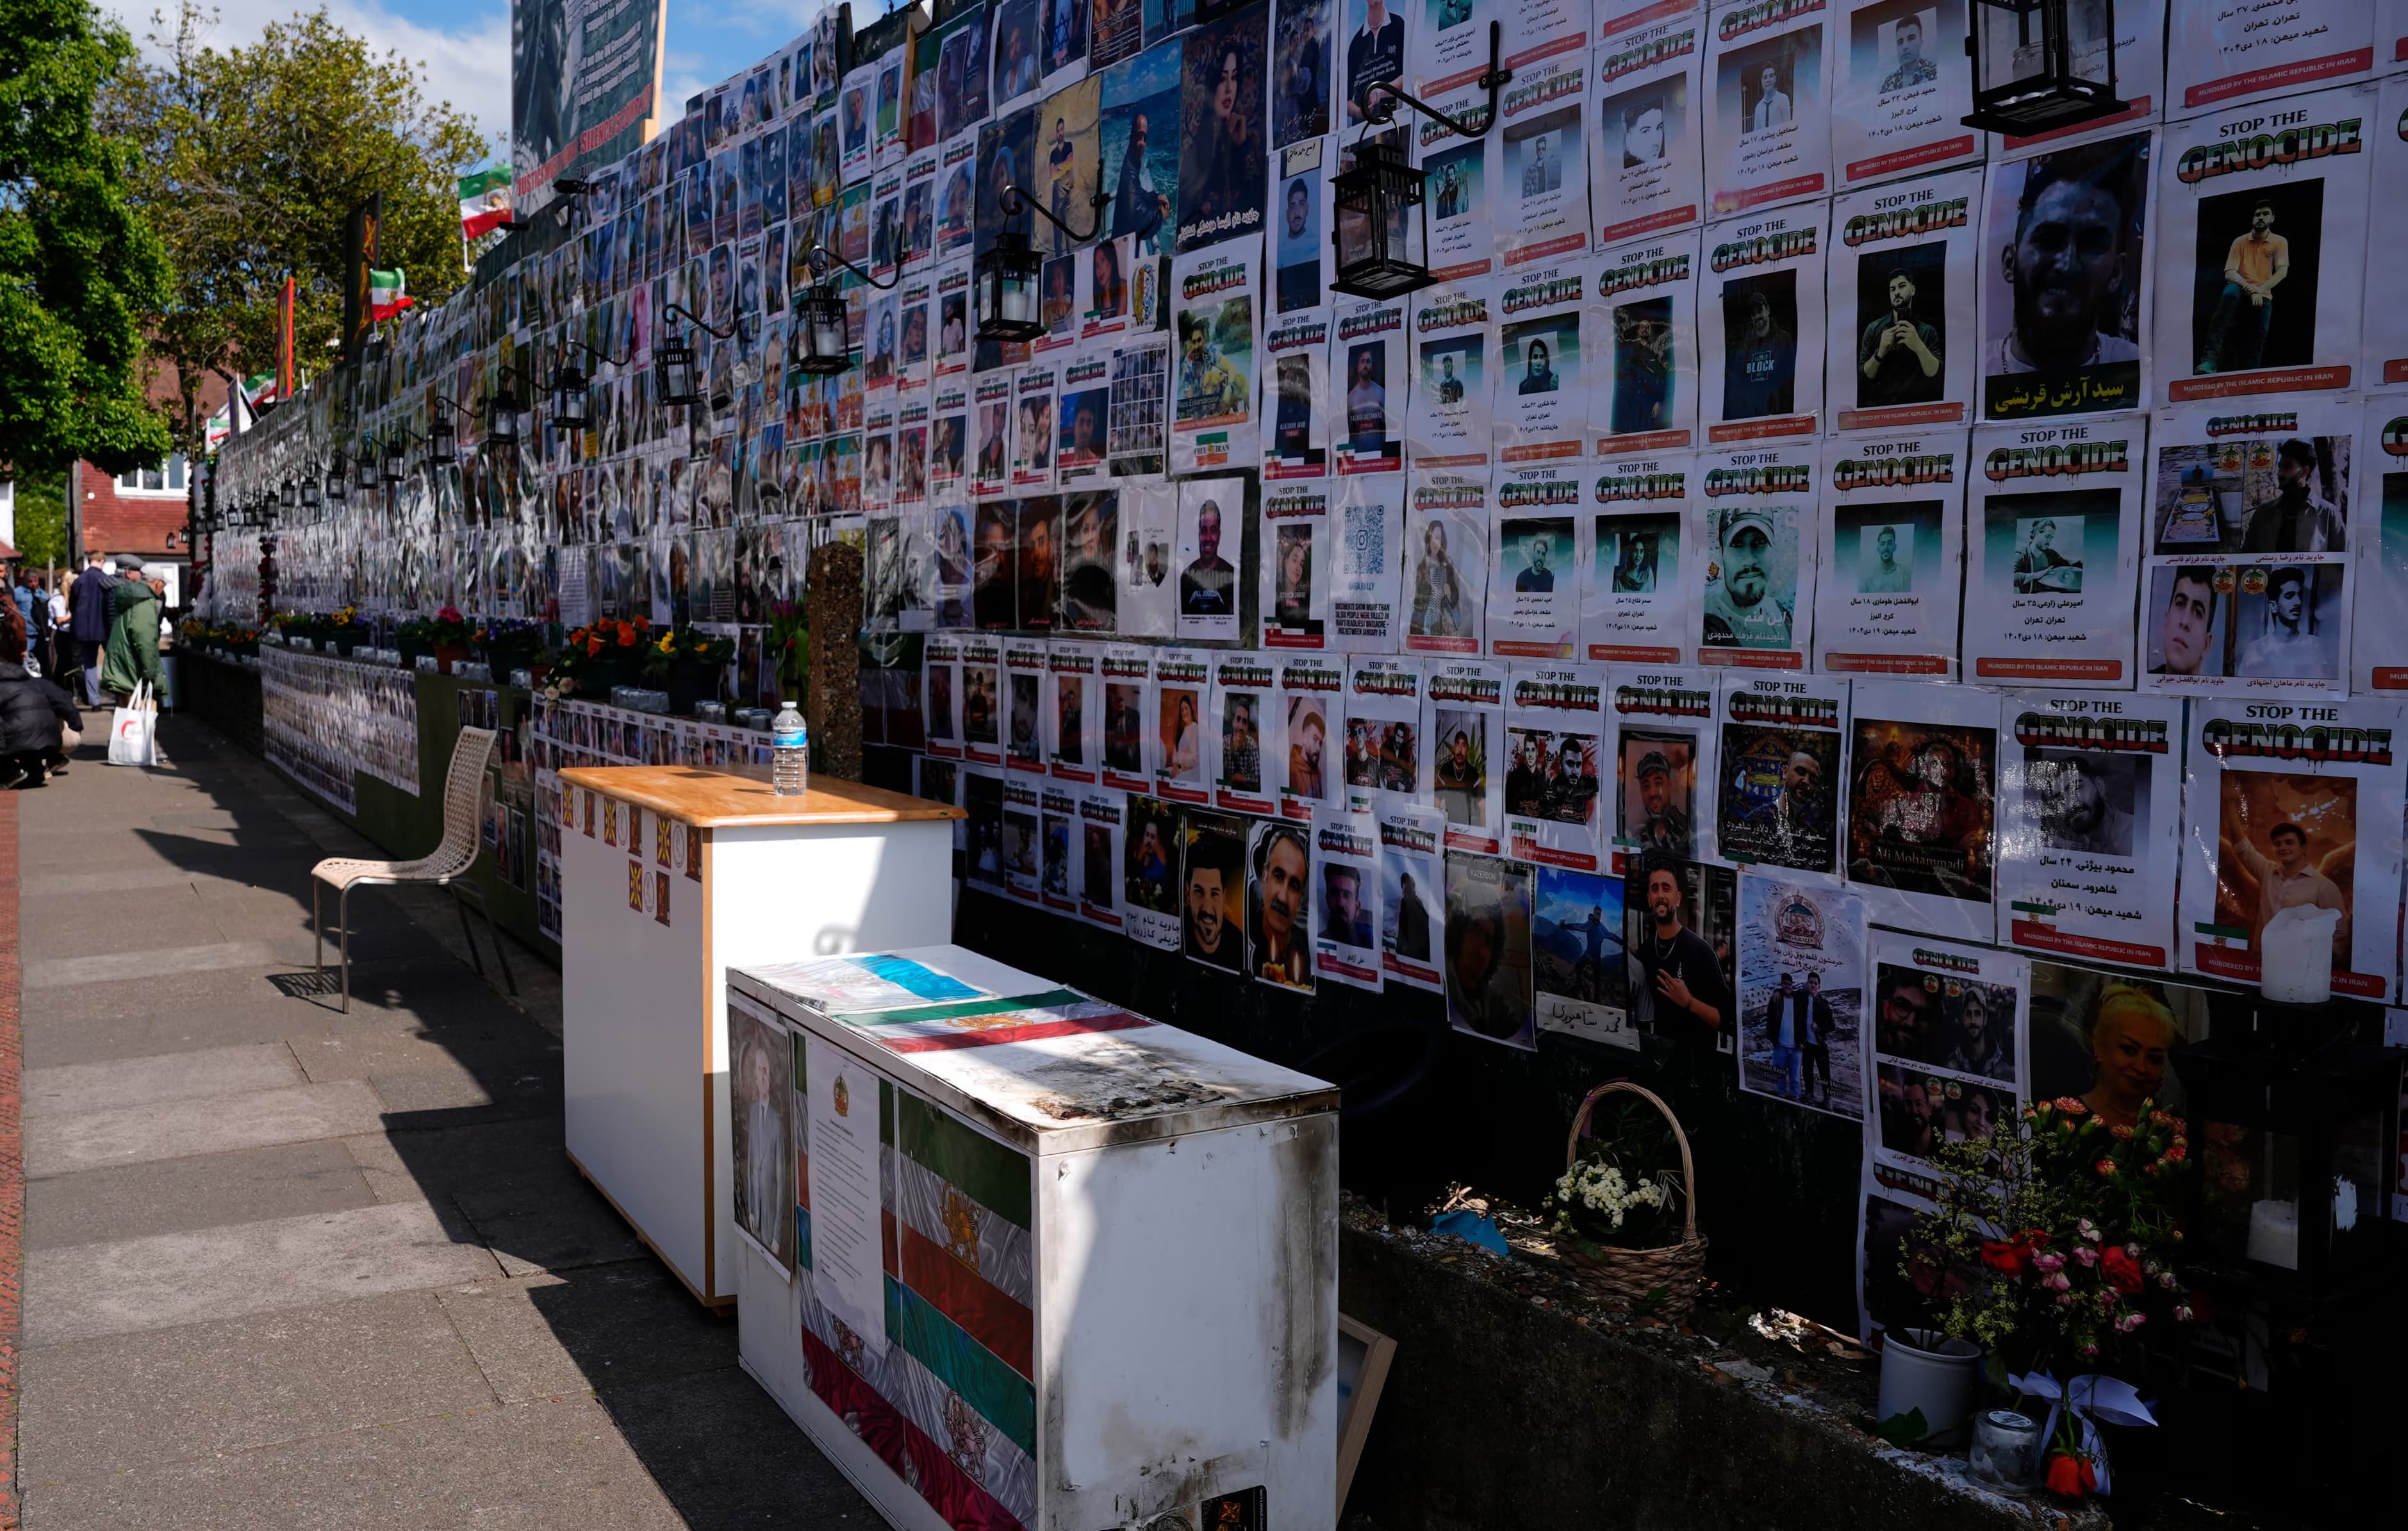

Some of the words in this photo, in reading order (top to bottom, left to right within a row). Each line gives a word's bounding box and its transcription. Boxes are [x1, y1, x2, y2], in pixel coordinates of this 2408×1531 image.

[2244, 19, 2268, 32] تهران
[2302, 25, 2328, 37] شهید
[1625, 33, 1647, 48] STOP
[1649, 26, 1669, 38] THE
[1603, 28, 1695, 83] GENOCIDE
[1521, 70, 1541, 85] STOP
[1542, 64, 1560, 78] THE
[2198, 82, 2232, 97] MURDERED
[2243, 76, 2257, 85] THE
[2257, 70, 2288, 82] ISLAMIC
[2289, 63, 2325, 76] REPUBLIC
[2337, 56, 2356, 67] IRAN
[1503, 69, 1583, 117] GENOCIDE
[2219, 118, 2264, 138] STOP
[2270, 110, 2307, 128] THE
[1783, 155, 1798, 164] شهید
[2177, 118, 2362, 184] GENOCIDE
[1874, 194, 1906, 210] STOP
[1909, 189, 1934, 203] THE
[1737, 225, 1761, 238] STOP
[1765, 219, 1786, 231] THE
[1843, 197, 1968, 246] GENOCIDE
[1621, 252, 1644, 264] STOP
[1645, 247, 1665, 258] THE
[1711, 227, 1817, 273] GENOCIDE
[1198, 260, 1214, 272] STOP
[1216, 256, 1228, 266] THE
[1183, 263, 1246, 300] GENOCIDE
[1522, 272, 1542, 285] STOP
[1543, 269, 1559, 279] THE
[1599, 254, 1690, 296] GENOCIDE
[1435, 295, 1452, 305] STOP
[1453, 291, 1467, 302] THE
[1502, 276, 1582, 314] GENOCIDE
[1355, 303, 1370, 314] STOP
[1371, 301, 1382, 309] THE
[1417, 299, 1489, 333] GENOCIDE
[1283, 317, 1296, 327] STOP
[1297, 315, 1310, 324] THE
[1339, 307, 1402, 341] GENOCIDE
[1268, 322, 1326, 352] GENOCIDE
[1747, 360, 1774, 374] BLOCK
[2050, 376, 2090, 407] آرش
[2092, 383, 2124, 402] سید
[2183, 383, 2215, 392] MURDERED
[2238, 377, 2266, 386] ISLAMIC
[2267, 375, 2303, 385] REPUBLIC
[1995, 382, 2047, 412] قریشی
[2020, 430, 2056, 443] STOP
[2060, 427, 2088, 439] THE
[2206, 412, 2298, 437] GENOCIDE
[1731, 455, 1756, 466] STOP
[1758, 453, 1779, 463] THE
[1863, 444, 1893, 456] STOP
[1897, 442, 1921, 453] THE
[1617, 464, 1640, 474] STOP
[1642, 462, 1659, 471] THE
[1985, 440, 2128, 481] GENOCIDE
[1519, 471, 1540, 480] STOP
[1542, 470, 1557, 478] THE
[1704, 465, 1810, 497] GENOCIDE
[1834, 454, 1954, 491] GENOCIDE
[1414, 486, 1484, 511] GENOCIDE
[1499, 481, 1579, 508] GENOCIDE
[1596, 473, 1685, 503] GENOCIDE
[1266, 495, 1326, 518] GENOCIDE
[1767, 611, 1786, 626] این
[2024, 617, 2043, 625] تهران
[1369, 661, 1383, 670] STOP
[1385, 662, 1398, 670] THE
[1447, 666, 1464, 675] STOP
[1466, 668, 1481, 676] THE
[1536, 671, 1556, 680] STOP
[1558, 672, 1576, 681] THE
[1218, 665, 1273, 688] GENOCIDE
[1282, 667, 1341, 691] GENOCIDE
[1353, 670, 1417, 697] GENOCIDE
[1637, 675, 1661, 685] STOP
[1663, 676, 1683, 686] THE
[1754, 681, 1780, 692] STOP
[1784, 683, 1807, 693] THE
[1429, 675, 1501, 704] GENOCIDE
[1515, 681, 1599, 711] GENOCIDE
[1615, 685, 1711, 717] GENOCIDE
[1729, 691, 1838, 729] GENOCIDE
[2050, 699, 2088, 713] STOP
[2091, 701, 2123, 713] THE
[2247, 705, 2293, 719] STOP
[2298, 708, 2338, 722] THE
[2015, 712, 2168, 754] GENOCIDE
[2202, 718, 2392, 766] GENOCIDE
[1330, 822, 1344, 831] STOP
[1345, 825, 1357, 833] THE
[1390, 815, 1405, 825] STOP
[1407, 819, 1419, 827] THE
[1319, 829, 1373, 857] GENOCIDE
[1876, 847, 1891, 861] Ali
[1893, 851, 1965, 873] Mohammadi
[2040, 856, 2057, 866] سال
[2105, 865, 2134, 874] محمود
[2051, 879, 2079, 890] سمنان
[1143, 916, 1155, 925] نام
[1160, 920, 1179, 931] جاوید
[1912, 948, 1979, 975] GENOCIDE
[2209, 959, 2243, 970] MURDERED
[2348, 978, 2368, 987] IRAN
